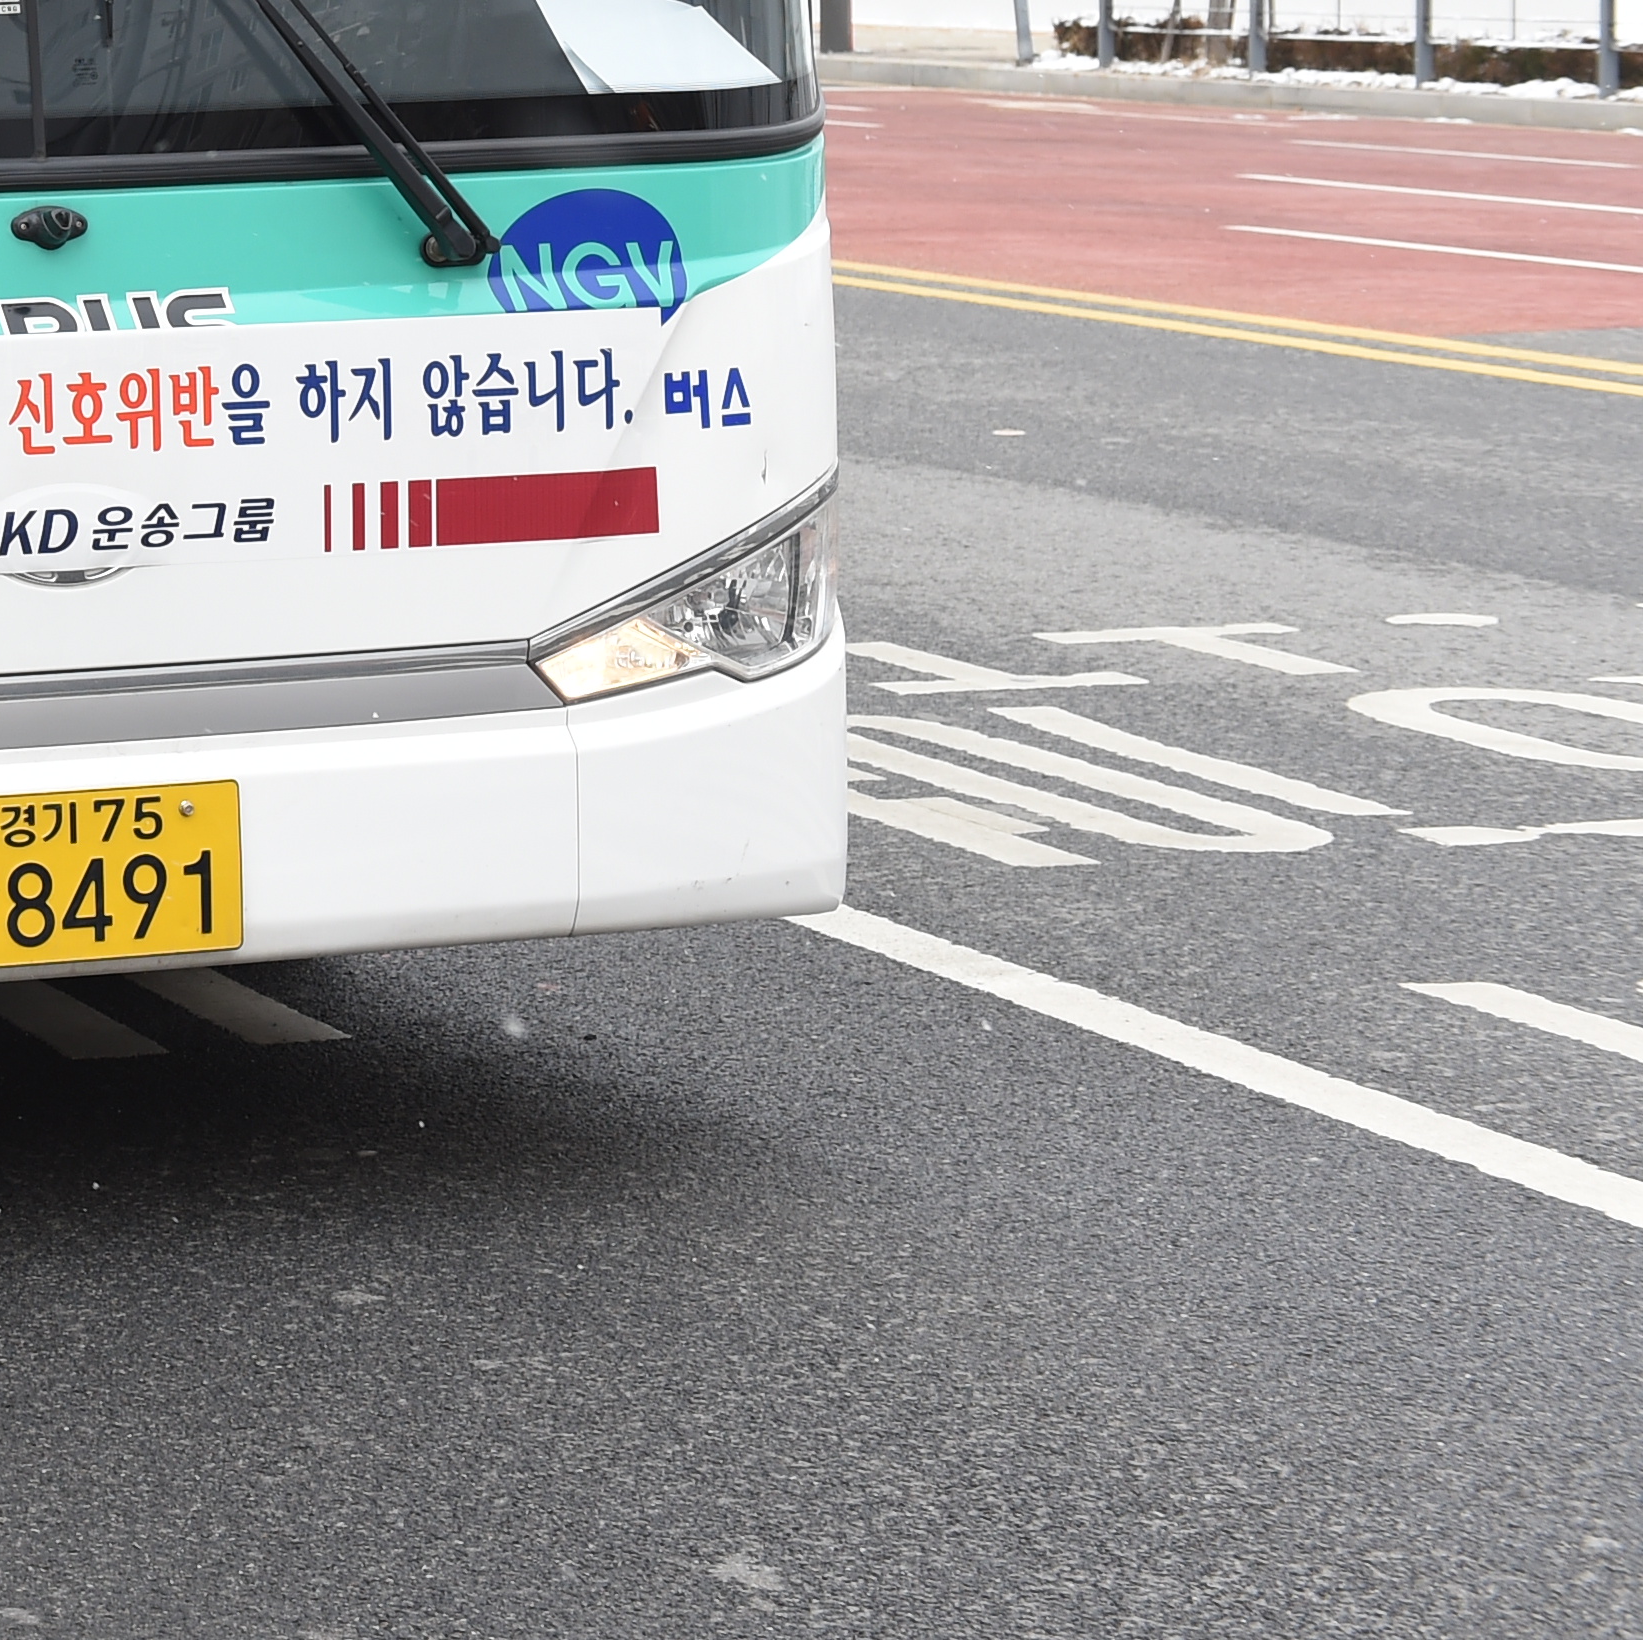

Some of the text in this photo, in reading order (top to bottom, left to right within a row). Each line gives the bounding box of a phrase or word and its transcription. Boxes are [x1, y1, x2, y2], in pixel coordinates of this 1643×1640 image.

[498, 240, 674, 312] NGV
[9, 363, 271, 456] 신호위반을
[295, 358, 393, 443] 하지
[422, 347, 635, 438] 않습니다.
[664, 367, 752, 429] 버스
[92, 497, 275, 551] 운송그룹
